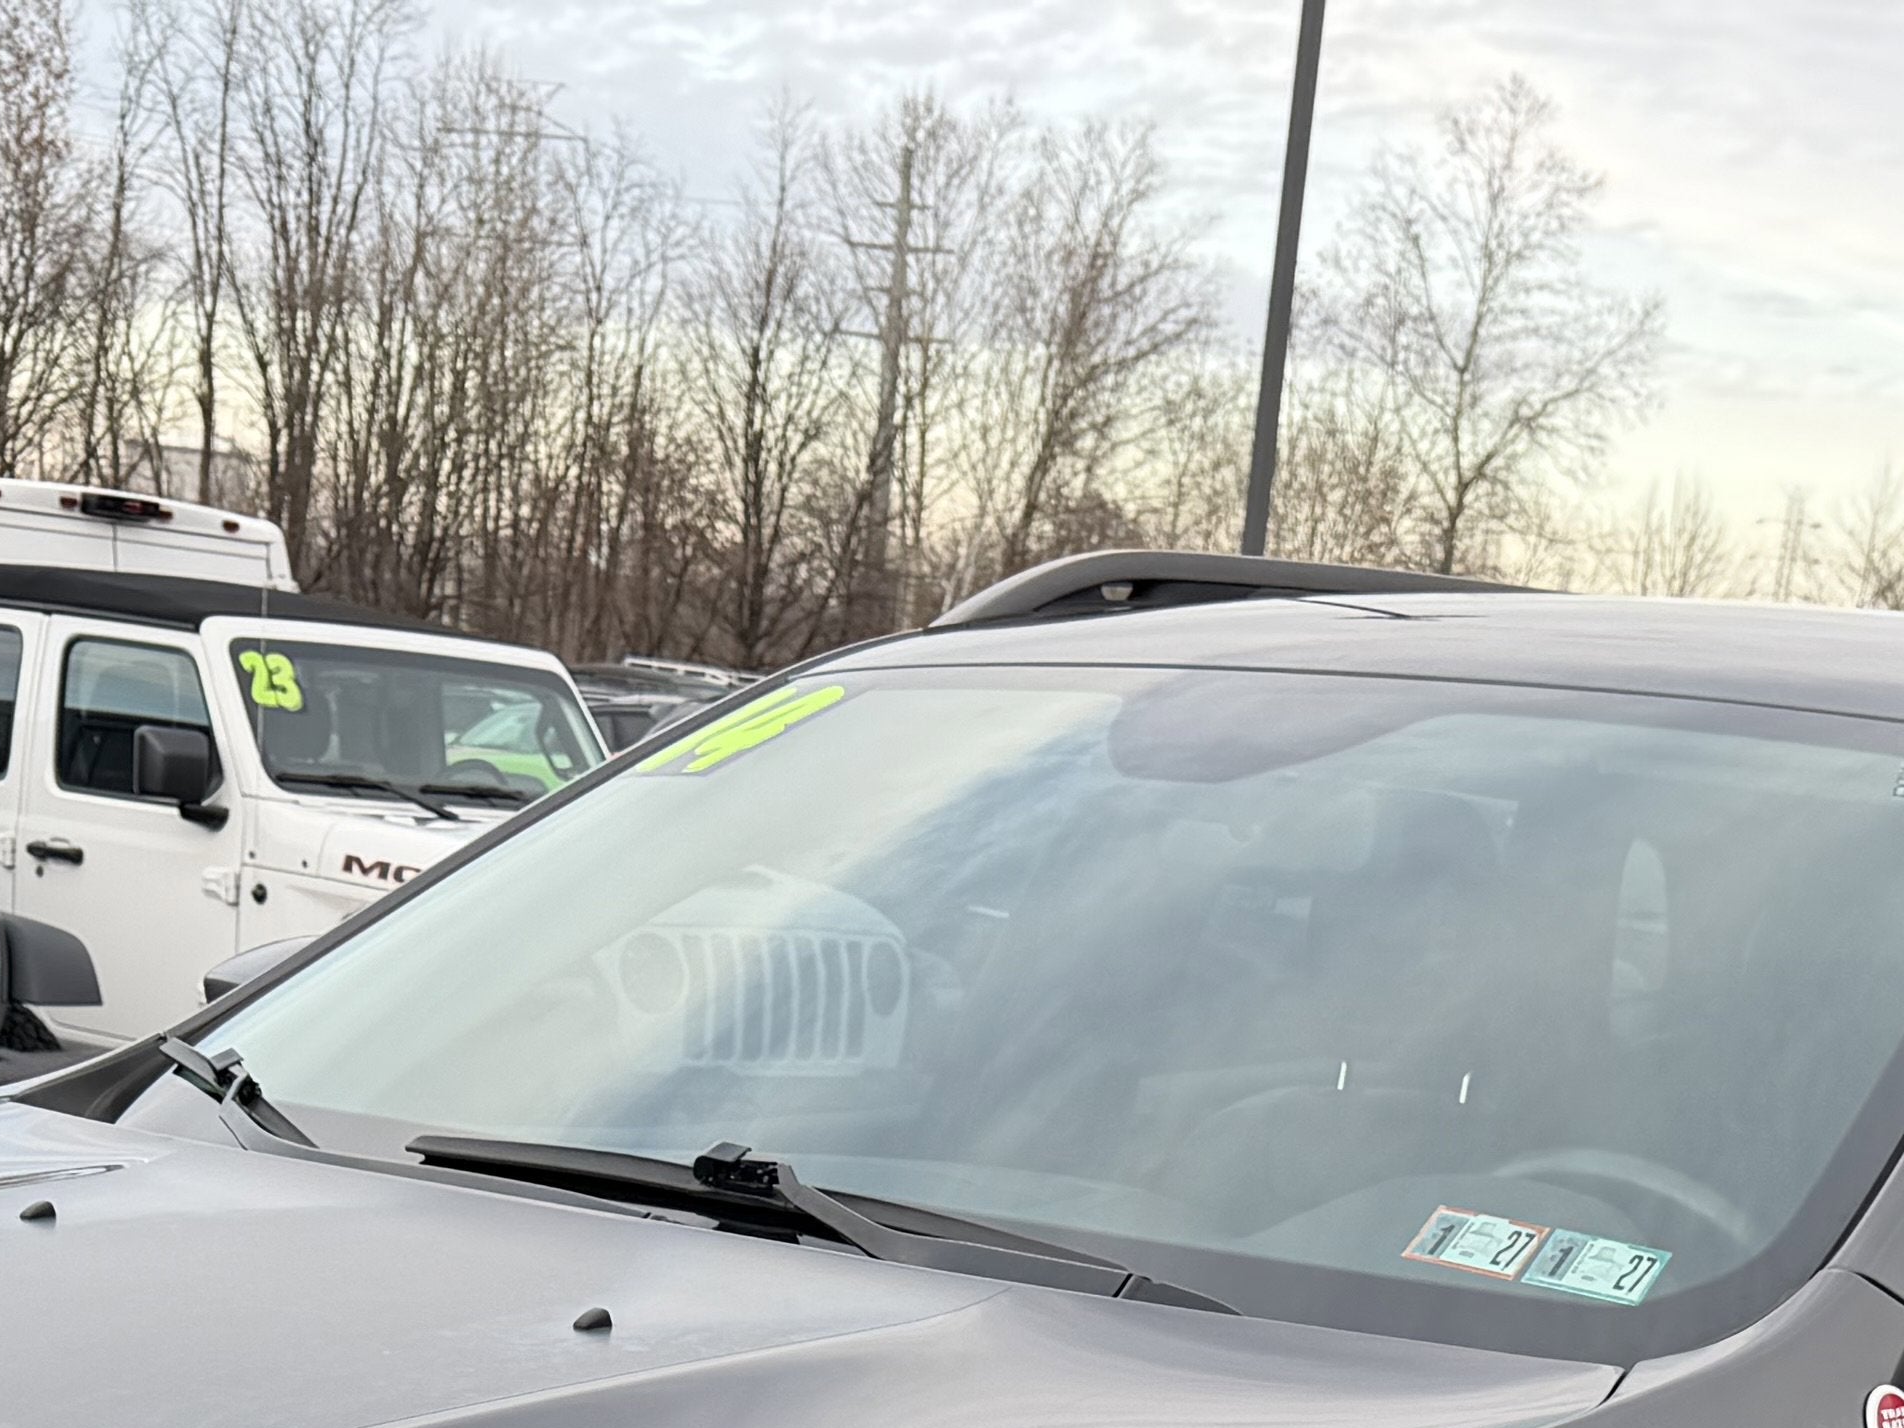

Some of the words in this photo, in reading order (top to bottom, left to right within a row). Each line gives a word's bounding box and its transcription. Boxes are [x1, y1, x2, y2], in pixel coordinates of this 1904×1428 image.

[239, 650, 304, 712] 23
[1427, 1223, 1456, 1255] 1
[1488, 1230, 1537, 1271] 27
[1548, 1246, 1575, 1277] 1
[1612, 1254, 1658, 1293] 27
